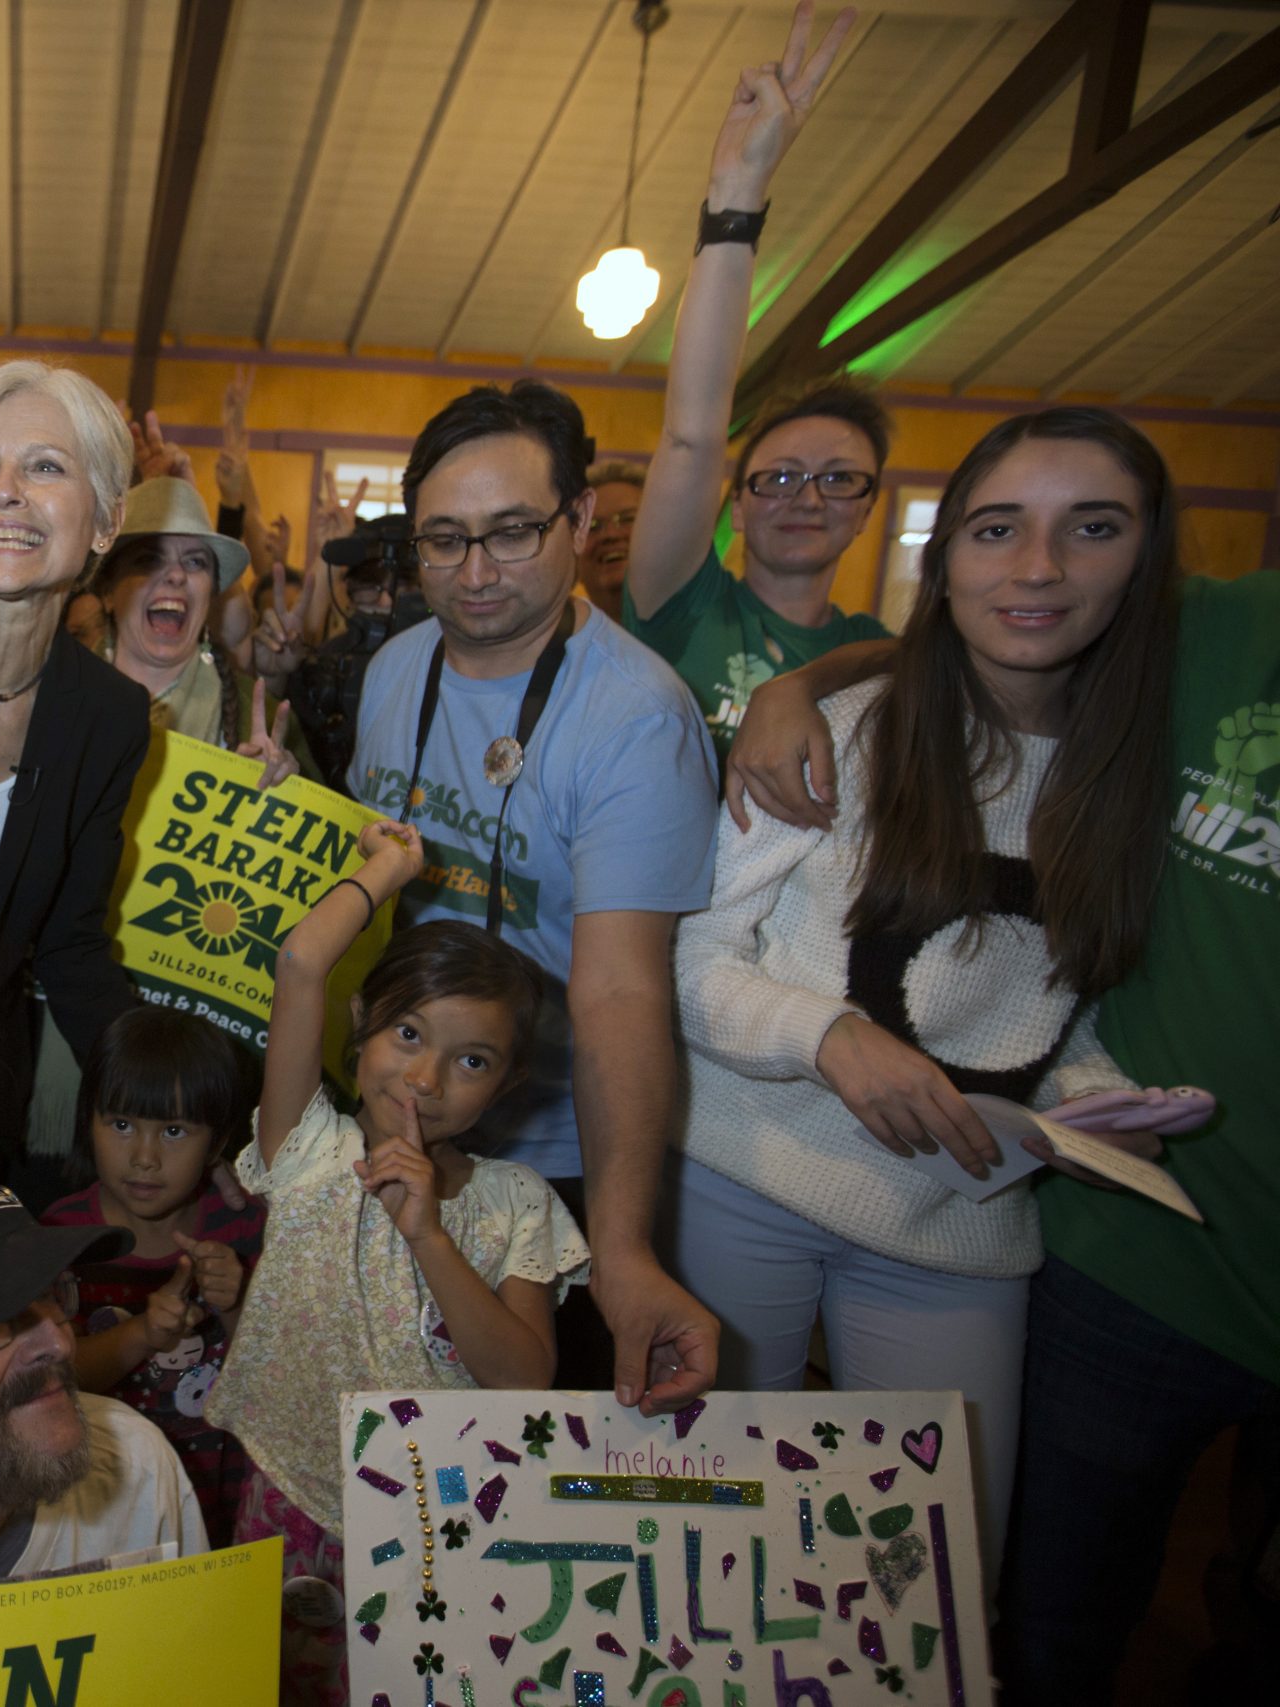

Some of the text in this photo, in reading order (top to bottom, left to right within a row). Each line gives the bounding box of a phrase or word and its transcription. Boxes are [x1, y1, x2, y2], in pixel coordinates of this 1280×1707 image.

[1180, 766, 1280, 811] PEOPLE, PLA
[172, 770, 361, 873] STEIN
[154, 819, 329, 909] BARAK
[1192, 856, 1219, 875] DR.
[1228, 871, 1271, 894] JILL
[148, 951, 272, 1008] JILL2016.COM
[138, 985, 171, 1006] net
[192, 1002, 252, 1040] Peace
[604, 1440, 726, 1479] melanie
[31, 1589, 51, 1603] PO
[56, 1584, 84, 1600] BOX
[87, 1576, 137, 1596] 260197,
[141, 1564, 199, 1585] MADISON,
[203, 1559, 218, 1573] WI
[219, 1551, 253, 1570] 53726
